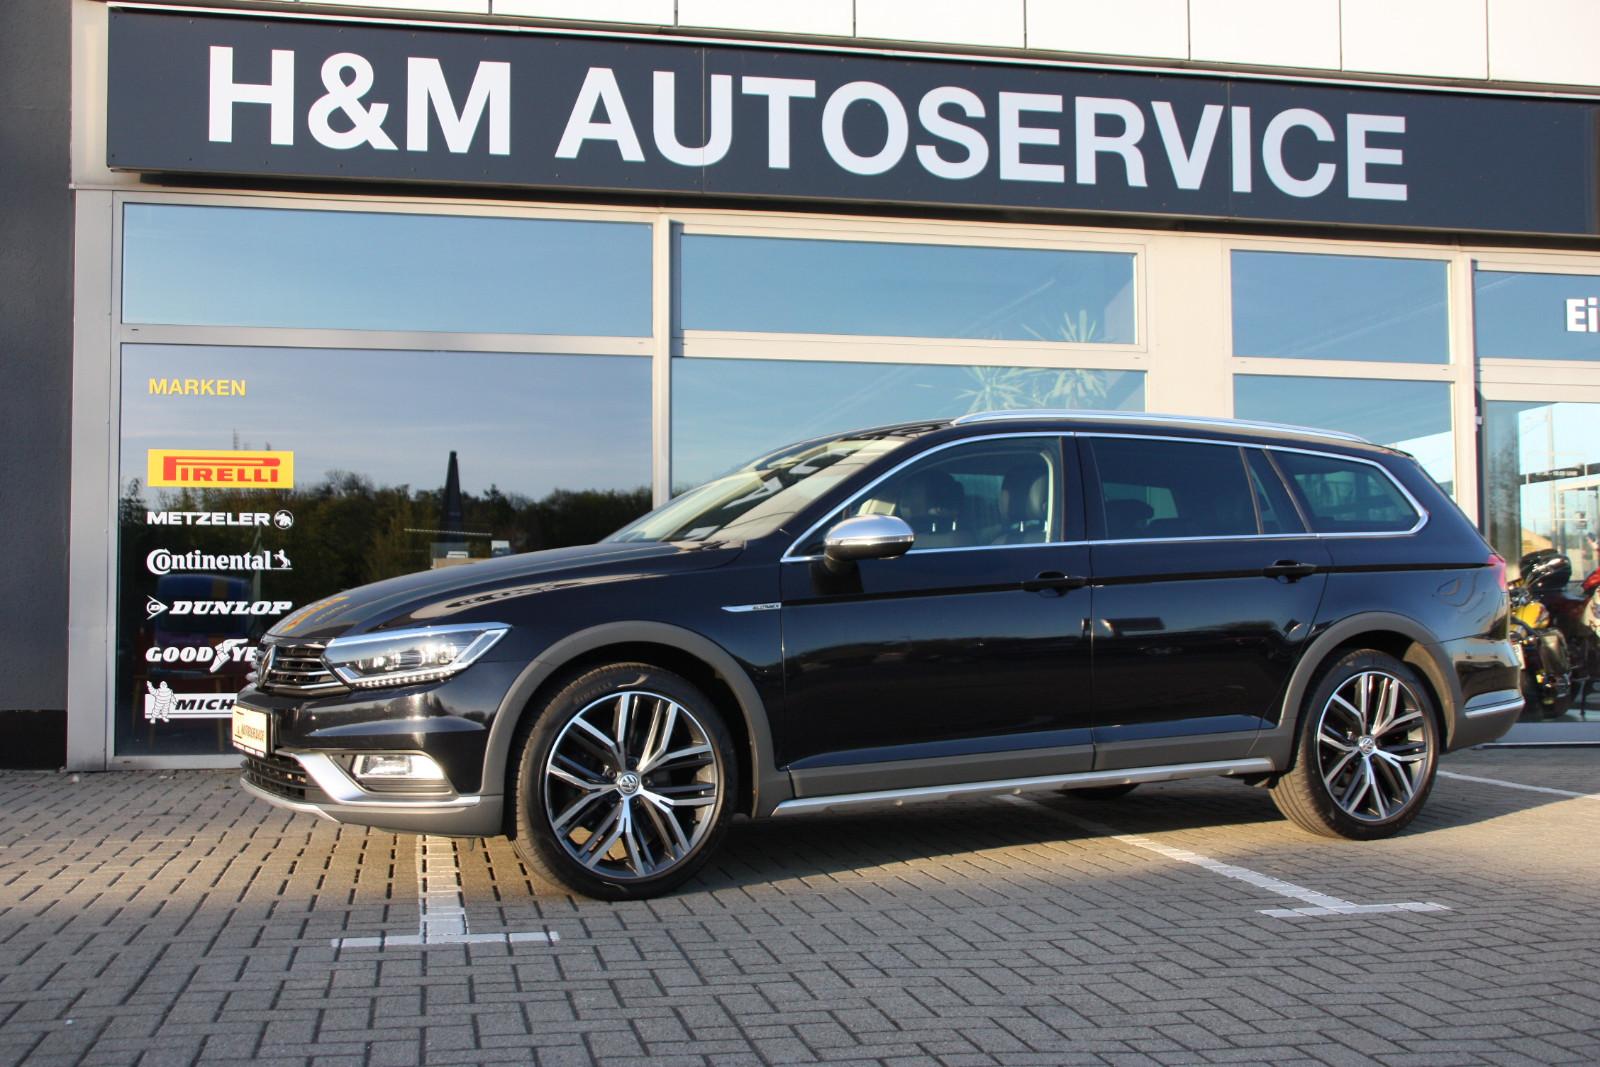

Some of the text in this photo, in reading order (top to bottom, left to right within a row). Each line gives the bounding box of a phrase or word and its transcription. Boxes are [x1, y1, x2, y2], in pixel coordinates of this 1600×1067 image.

[208, 45, 1408, 202] H&M AUTOSERVICE
[148, 378, 247, 397] MARKEN
[162, 455, 281, 483] PIRELLI
[146, 511, 271, 527] METZELER
[146, 547, 273, 576] Continental
[168, 600, 292, 616] DUNLOP
[145, 645, 258, 663] GOODYE
[174, 699, 235, 710] MICH
